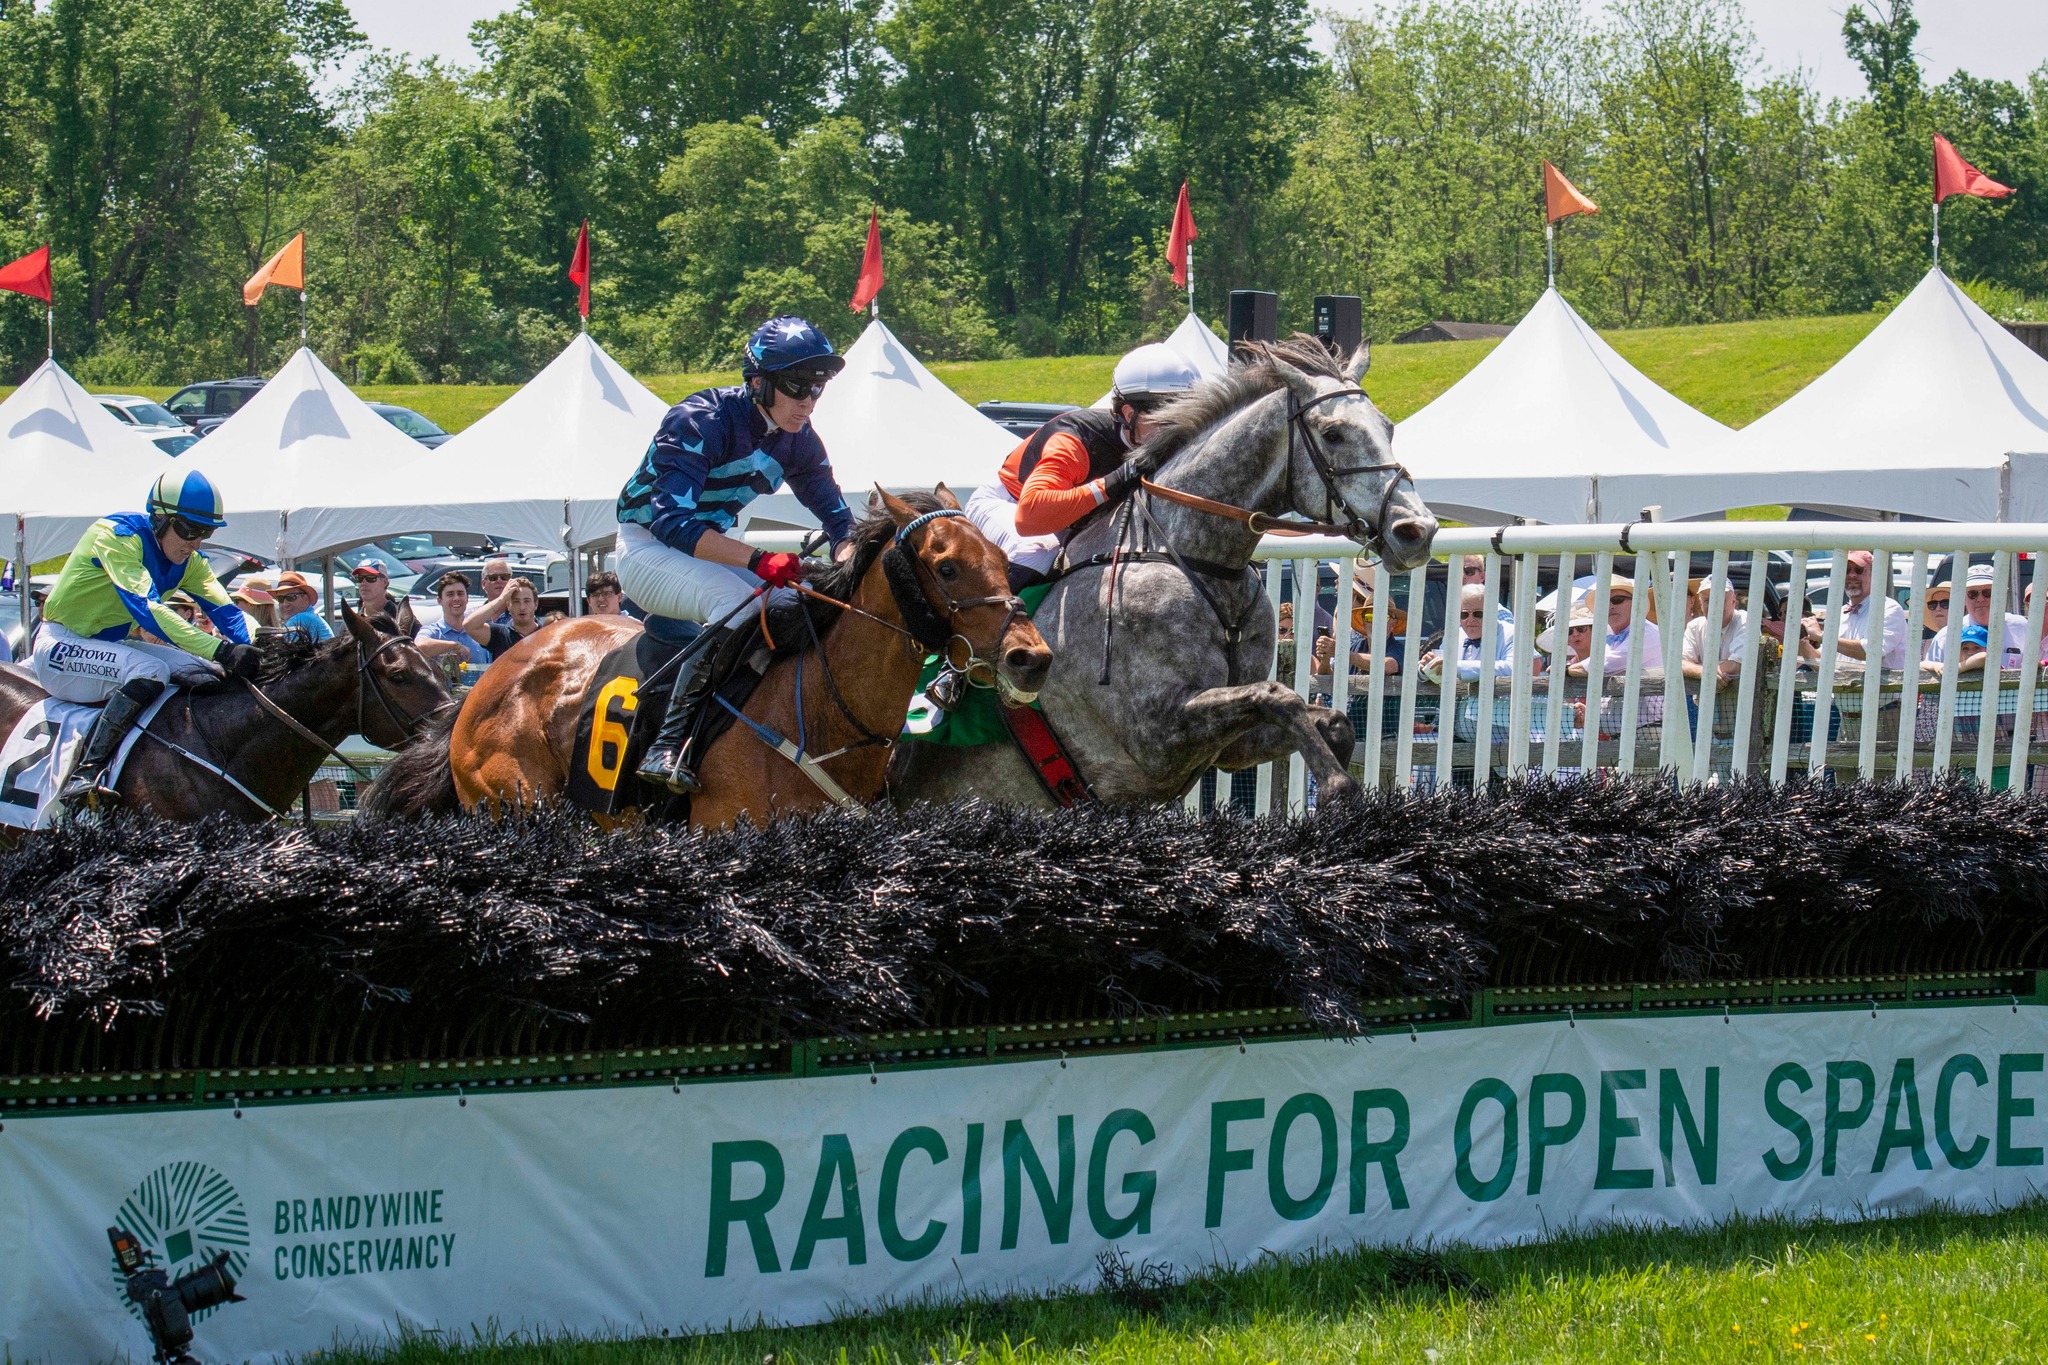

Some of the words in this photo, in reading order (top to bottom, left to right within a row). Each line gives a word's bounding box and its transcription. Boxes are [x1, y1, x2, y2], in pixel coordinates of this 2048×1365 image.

[66, 661, 120, 678] ADVISORY
[69, 644, 117, 663] Brown
[587, 676, 639, 791] 6
[0, 720, 61, 809] 2
[704, 1108, 1157, 1278] RACING
[1204, 1088, 1410, 1228] FOR
[1454, 1066, 1719, 1202] OPEN
[1762, 1053, 2045, 1181] SPACE
[274, 1189, 444, 1235] BRANDYWINE
[274, 1233, 456, 1281] CONSERVANCY
